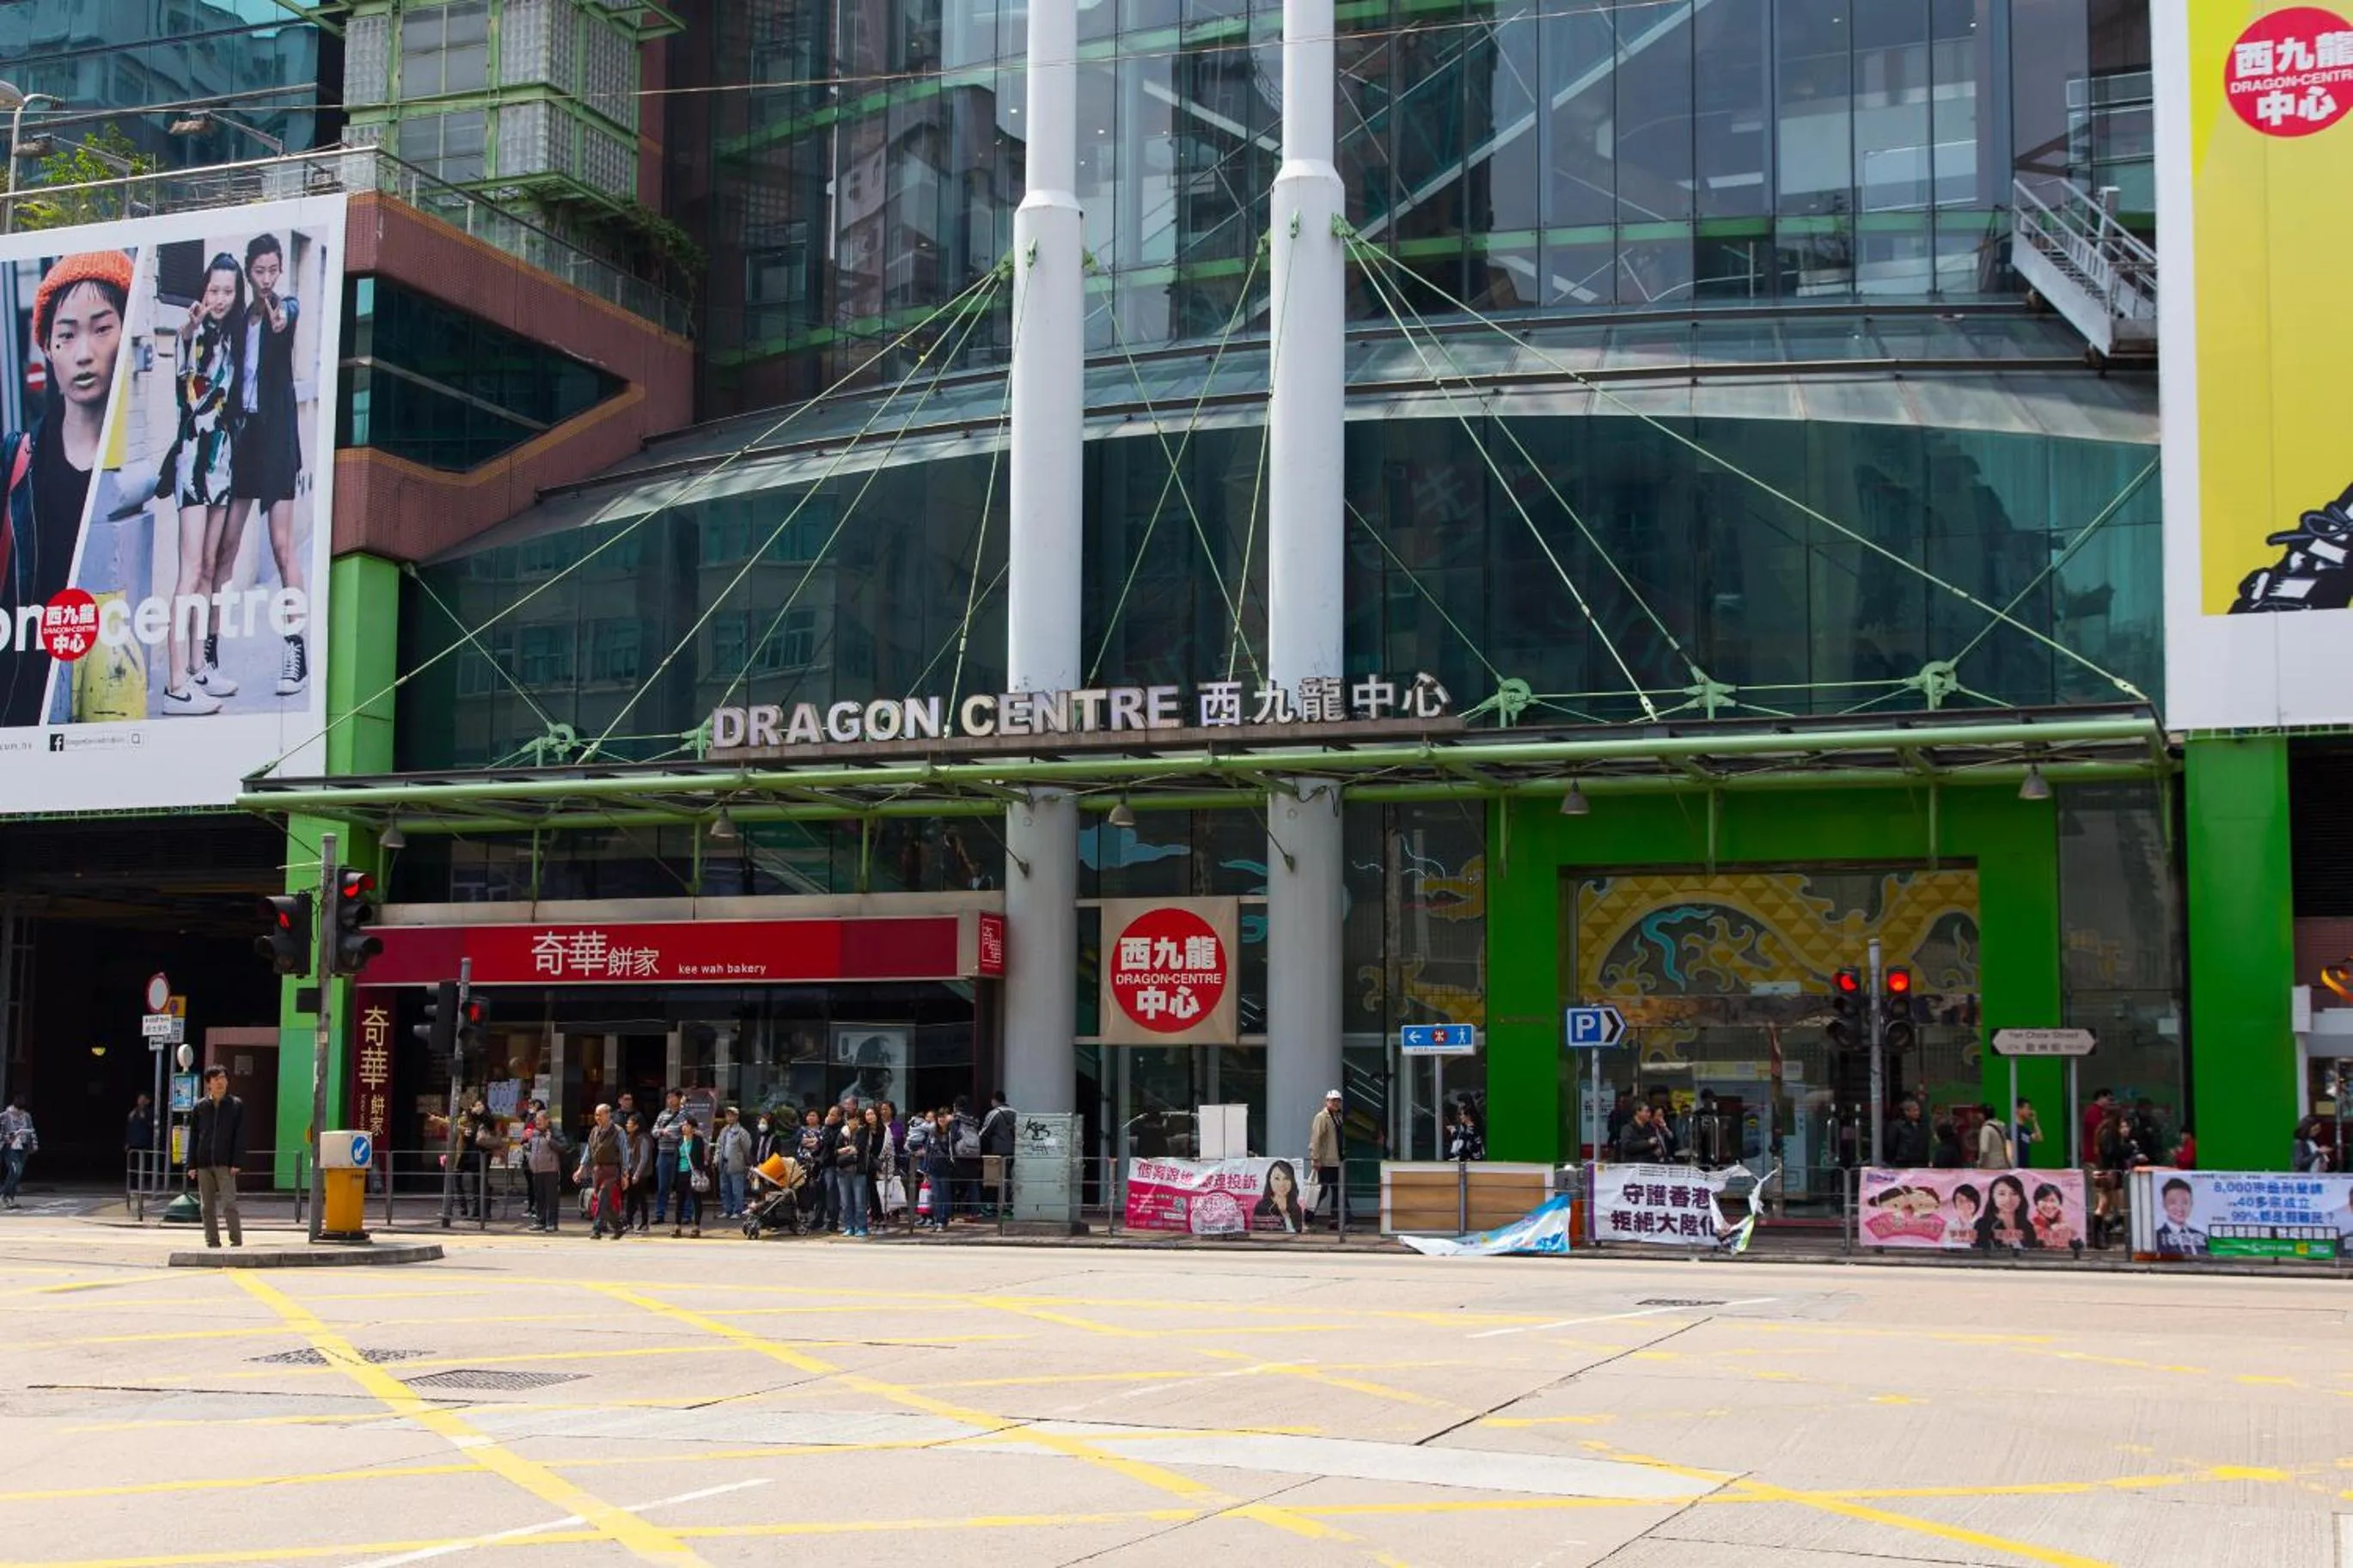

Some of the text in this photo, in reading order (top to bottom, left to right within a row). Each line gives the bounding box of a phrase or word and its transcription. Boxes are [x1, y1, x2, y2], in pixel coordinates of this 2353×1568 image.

[2235, 31, 2353, 78] 西九龍
[2230, 69, 2353, 95] DRAGON-CENTR
[2257, 85, 2338, 126] 中心
[46, 603, 95, 625] 西九龍
[98, 580, 309, 646] centre
[52, 634, 86, 654] 中心
[712, 672, 1452, 748] DRAGON CENTRE 西九龍中心
[531, 930, 660, 977] 奇華餅家
[678, 963, 767, 975] kee wah bakery
[1120, 936, 1217, 971] 西九龍
[1137, 985, 1201, 1020] 中心
[1576, 1014, 1596, 1040] P
[1623, 1183, 1710, 1210] 守護香港
